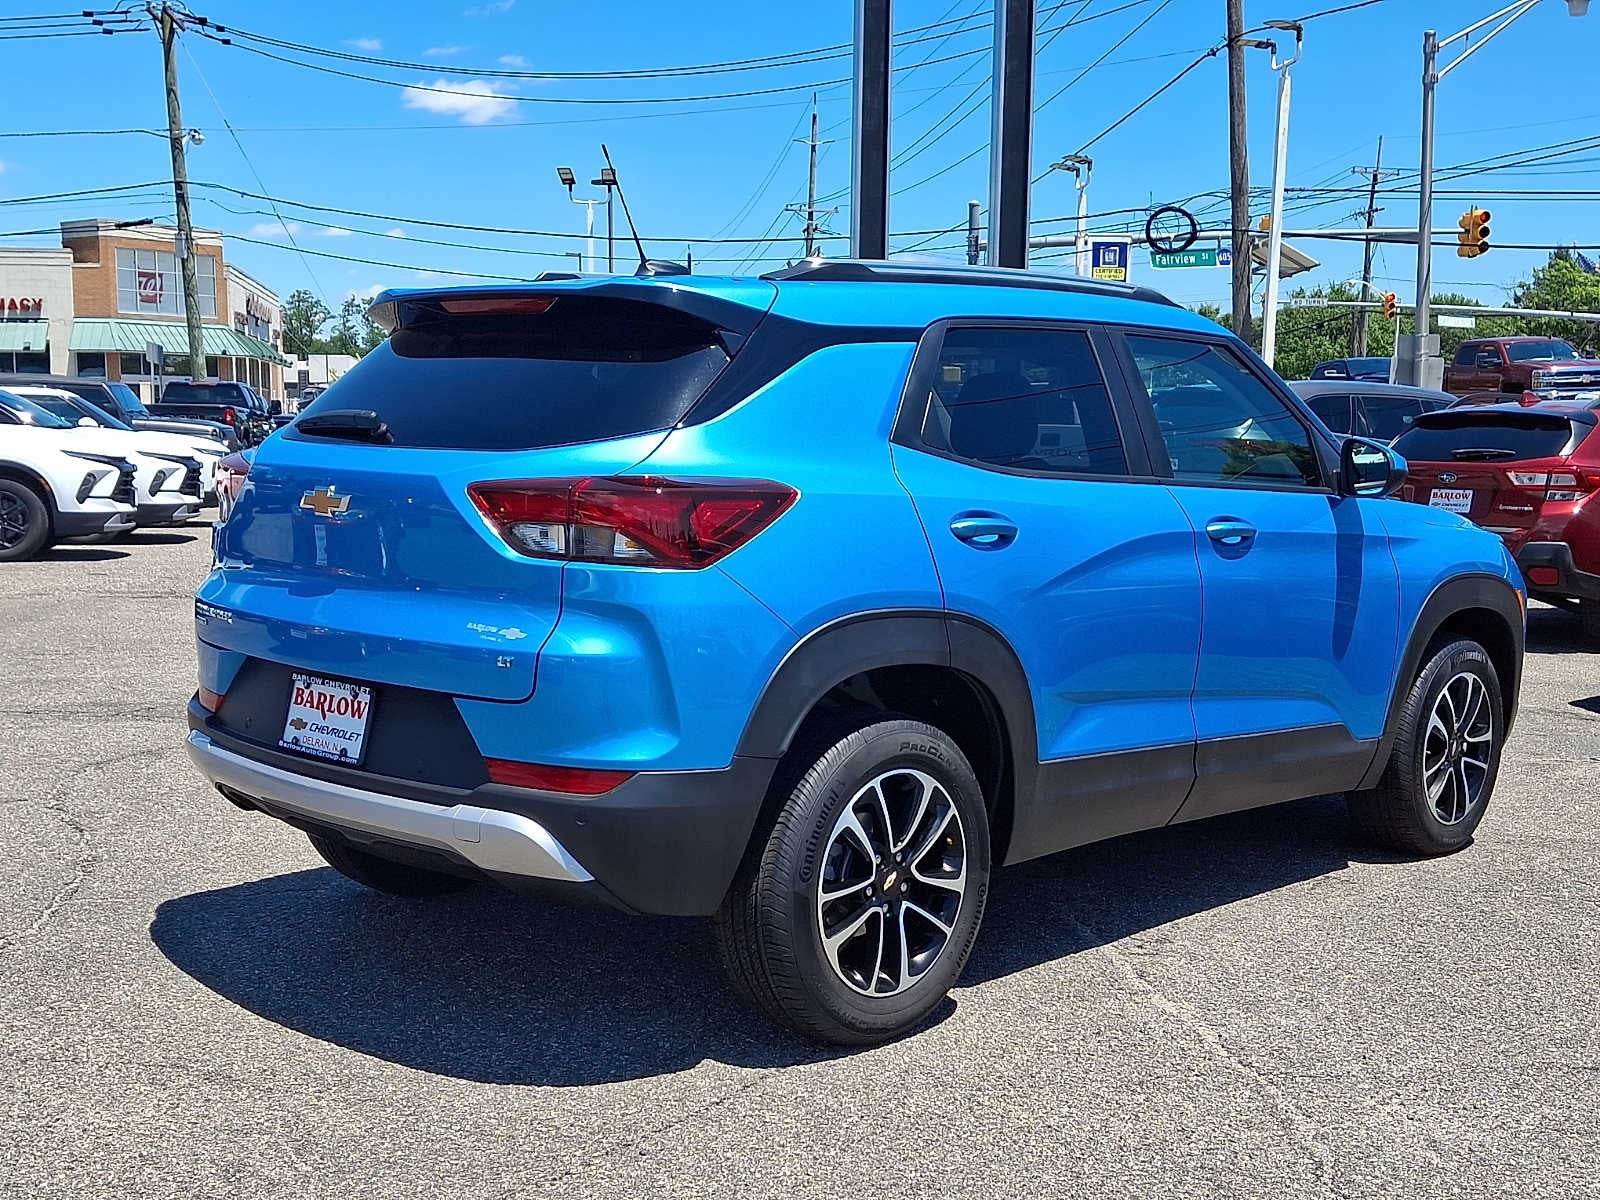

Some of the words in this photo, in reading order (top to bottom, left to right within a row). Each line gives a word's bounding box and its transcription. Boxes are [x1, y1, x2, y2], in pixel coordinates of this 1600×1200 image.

[1155, 254, 1196, 265] Fairview
[1218, 252, 1231, 261] 605
[1432, 491, 1471, 502] BARLOW
[496, 655, 515, 668] LT
[292, 673, 323, 685] BARLOW
[324, 679, 370, 695] CHEVROLET
[293, 687, 368, 721] BARLOW
[309, 722, 362, 742] CHEVROLET
[278, 740, 358, 764] BarlowAutoGroup.com
[799, 786, 840, 884] Continental
